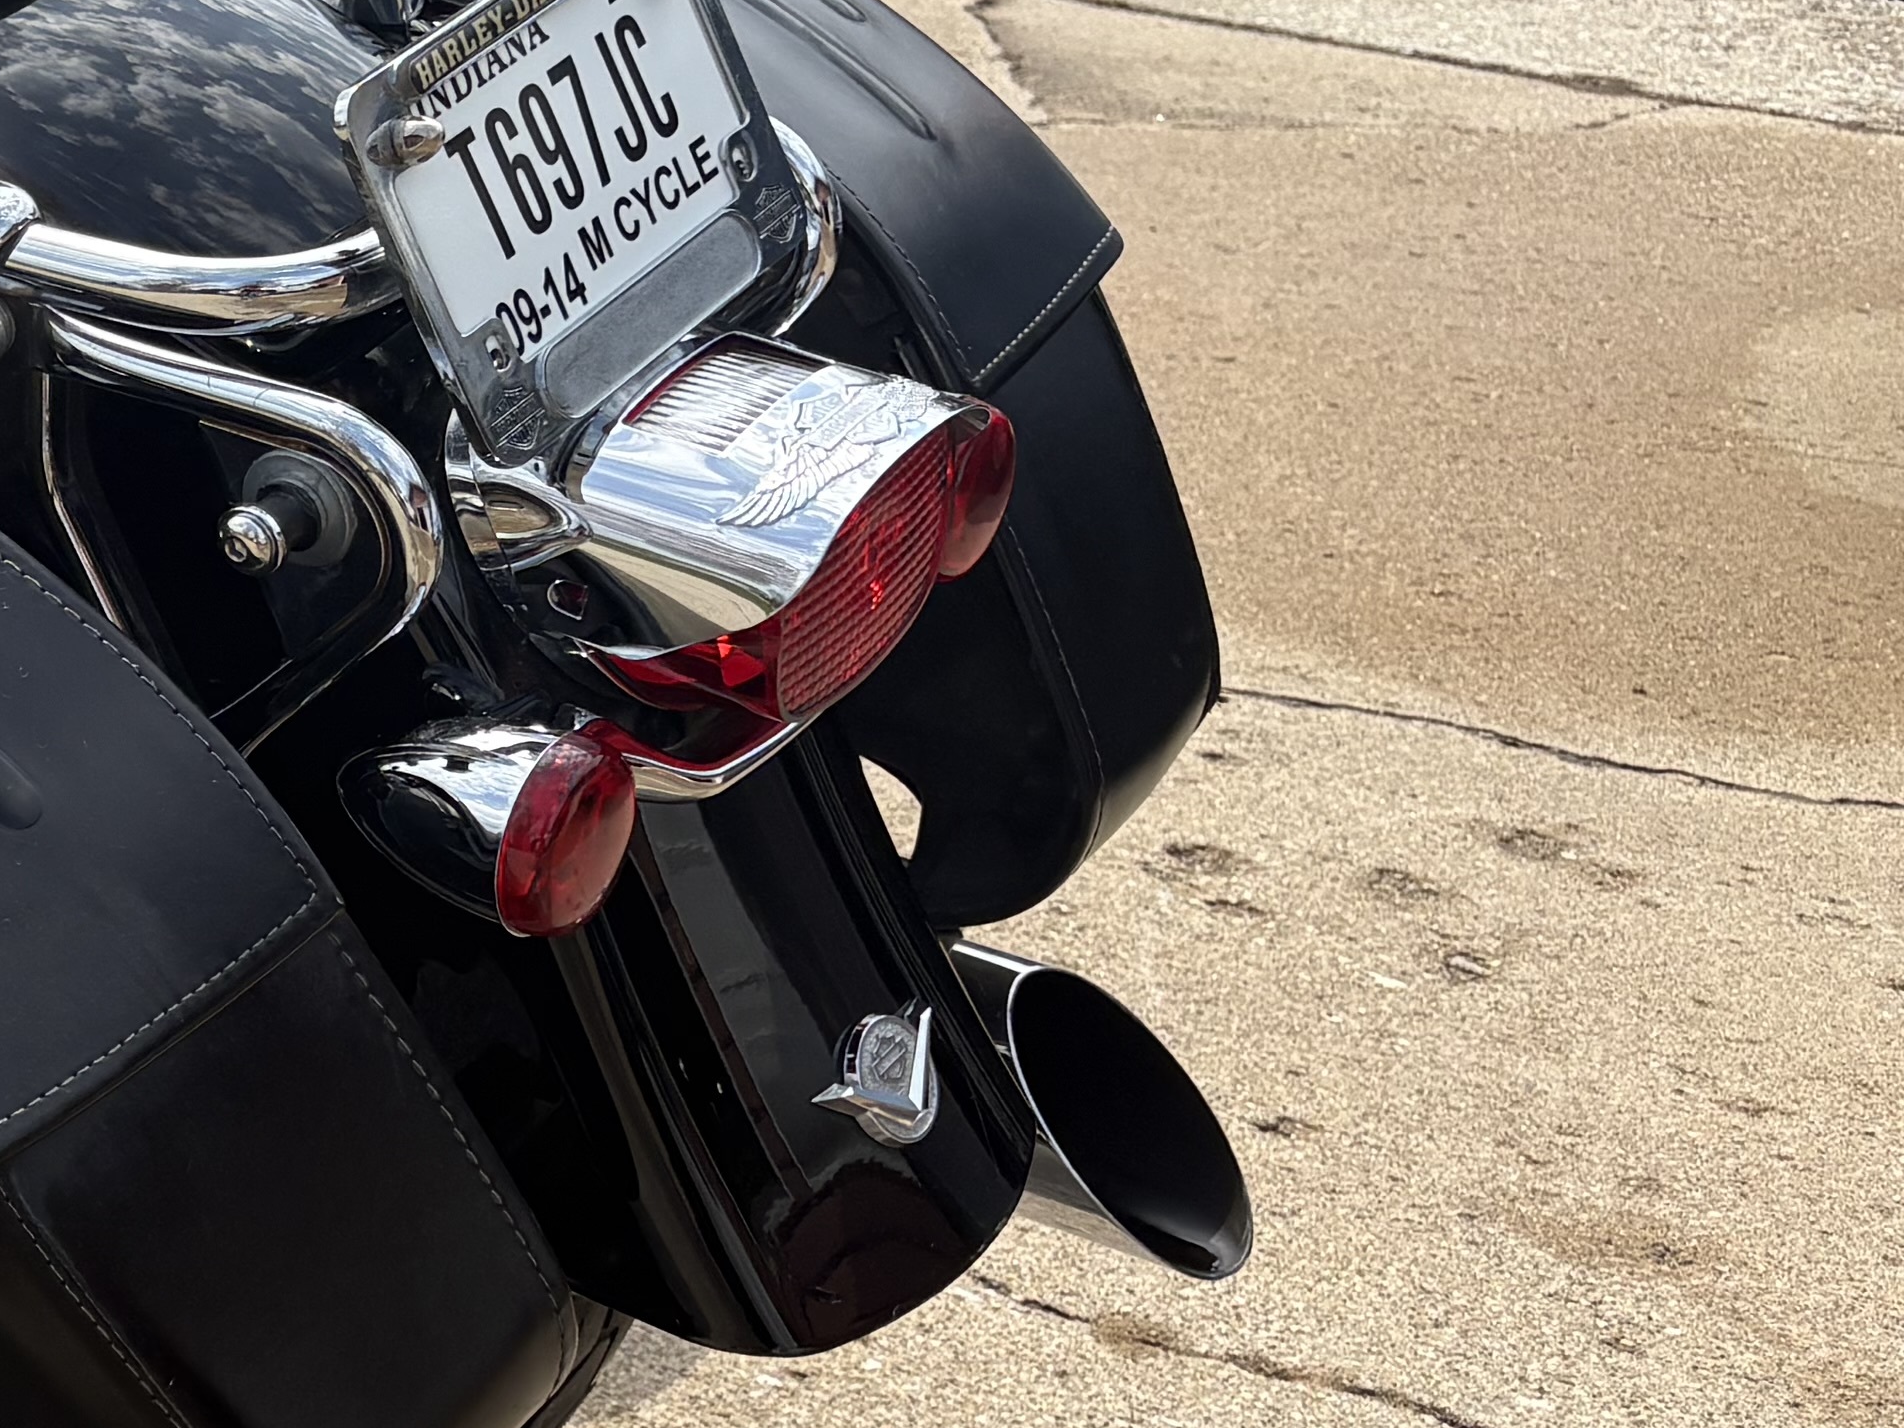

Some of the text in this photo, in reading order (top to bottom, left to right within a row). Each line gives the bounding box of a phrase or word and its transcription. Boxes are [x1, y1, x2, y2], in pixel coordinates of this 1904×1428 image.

[444, 15, 679, 260] T697JC
[496, 252, 588, 356] 09-14
[577, 215, 614, 271] M
[613, 135, 719, 241] CYCLE
